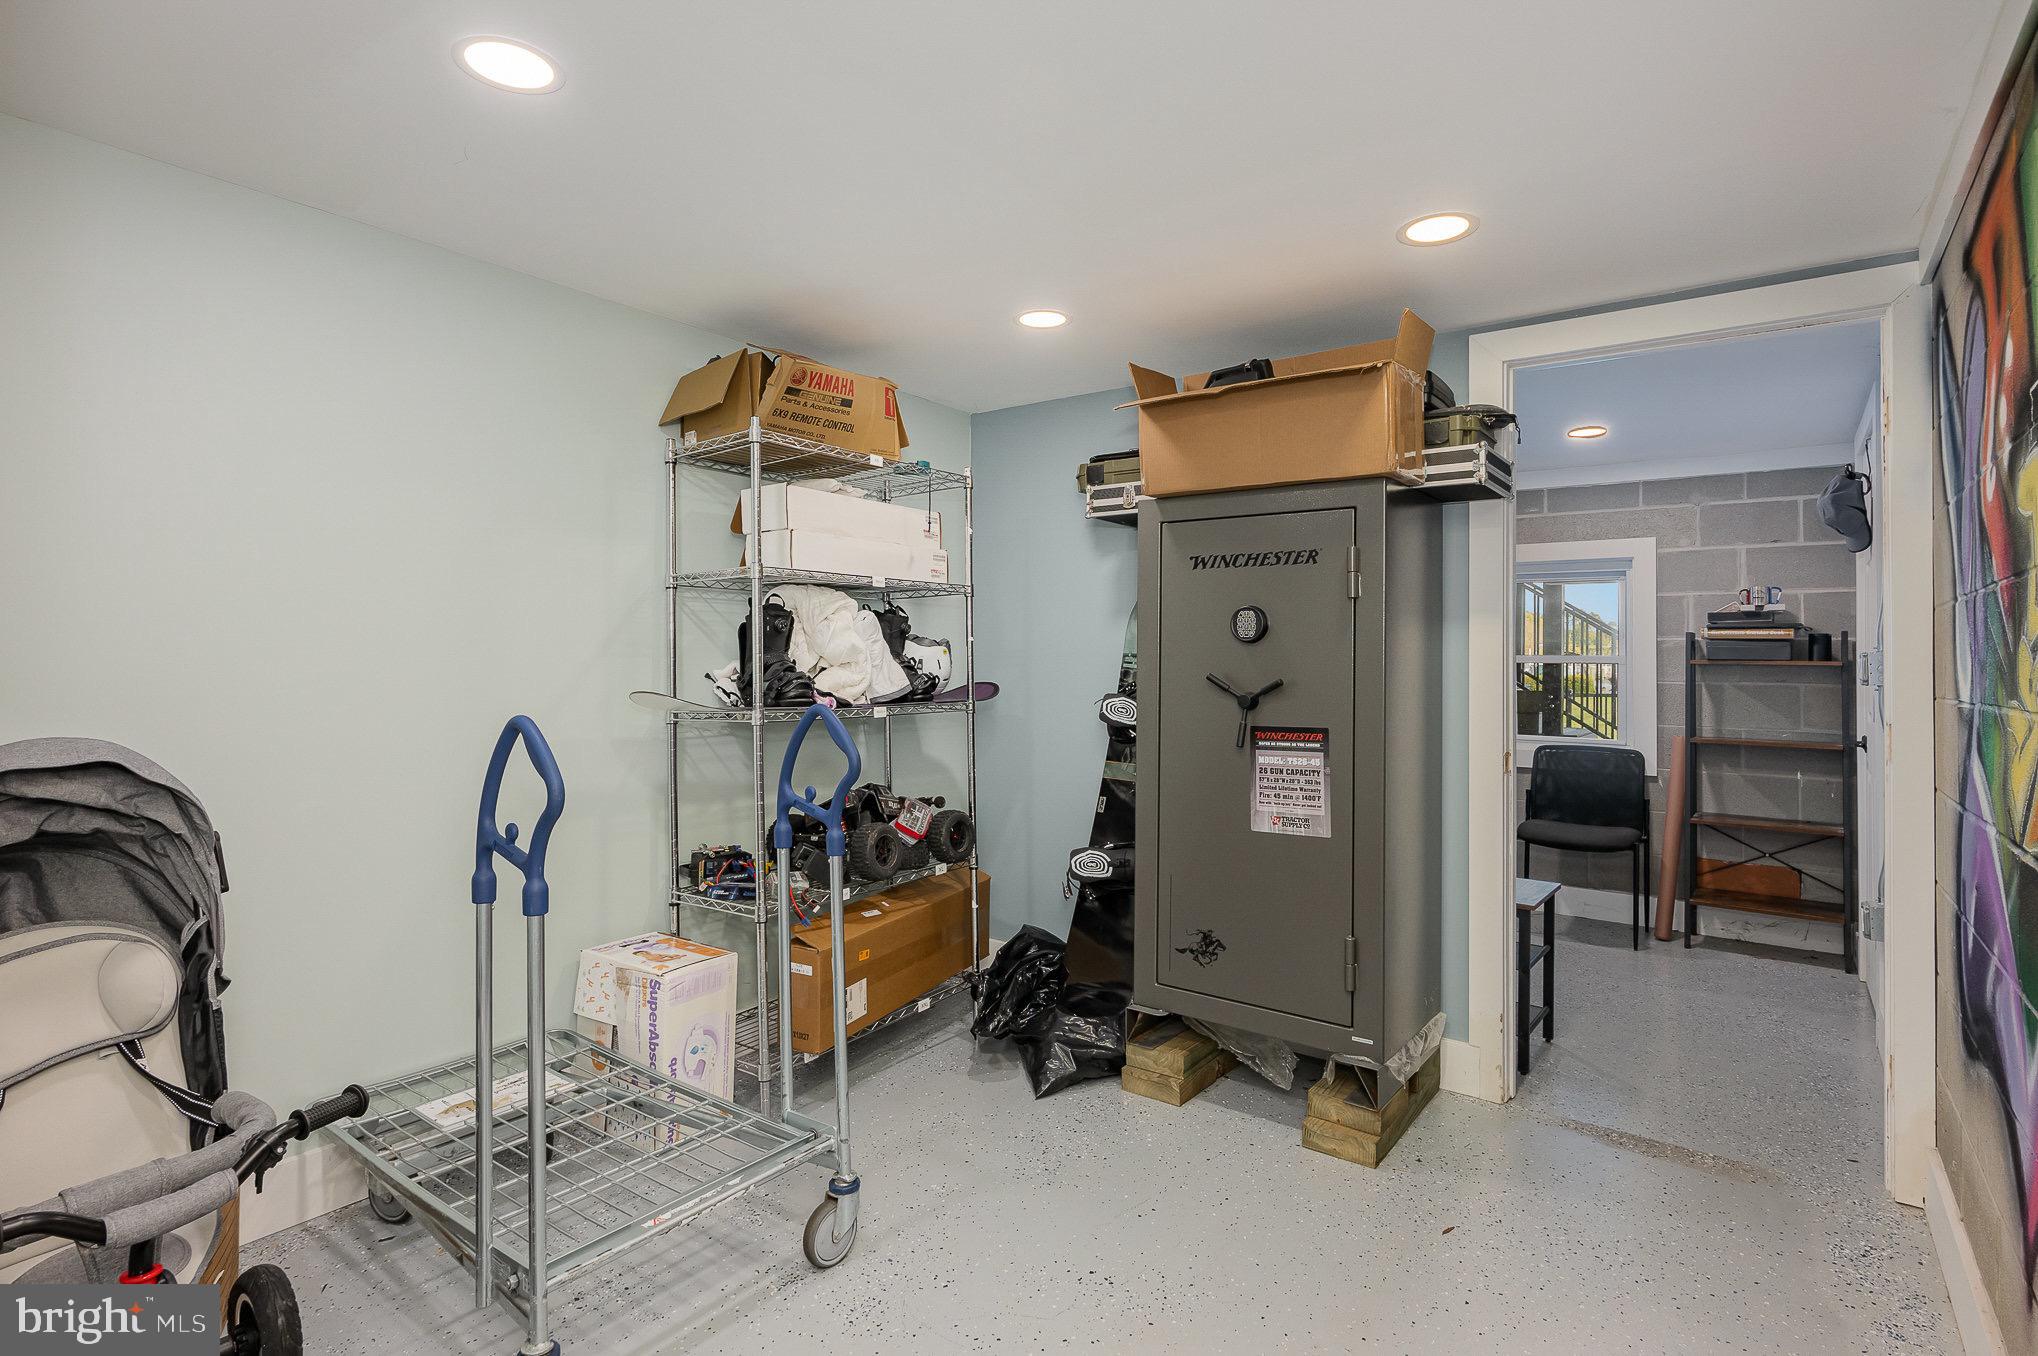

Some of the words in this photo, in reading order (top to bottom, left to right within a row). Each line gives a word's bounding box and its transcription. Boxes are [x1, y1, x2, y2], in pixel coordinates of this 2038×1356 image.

[807, 370, 855, 397] YAMAHA
[800, 390, 843, 406] GENUINE
[780, 395, 801, 406] Parts
[810, 402, 851, 416] Accessories
[772, 408, 788, 419] 6X9
[789, 411, 822, 428] REMOTE
[822, 418, 855, 434] CONTROL
[766, 422, 787, 432] YAMAHA
[788, 427, 806, 435] MOTOR
[1189, 549, 1319, 570] WINCHESTER
[1255, 731, 1324, 741] WINCHESTER
[1258, 756, 1286, 765] MODEL:
[1258, 767, 1268, 775] 26
[1270, 767, 1284, 775] GUN
[1285, 768, 1321, 777] CAPACITY
[1299, 786, 1321, 794] Warranty
